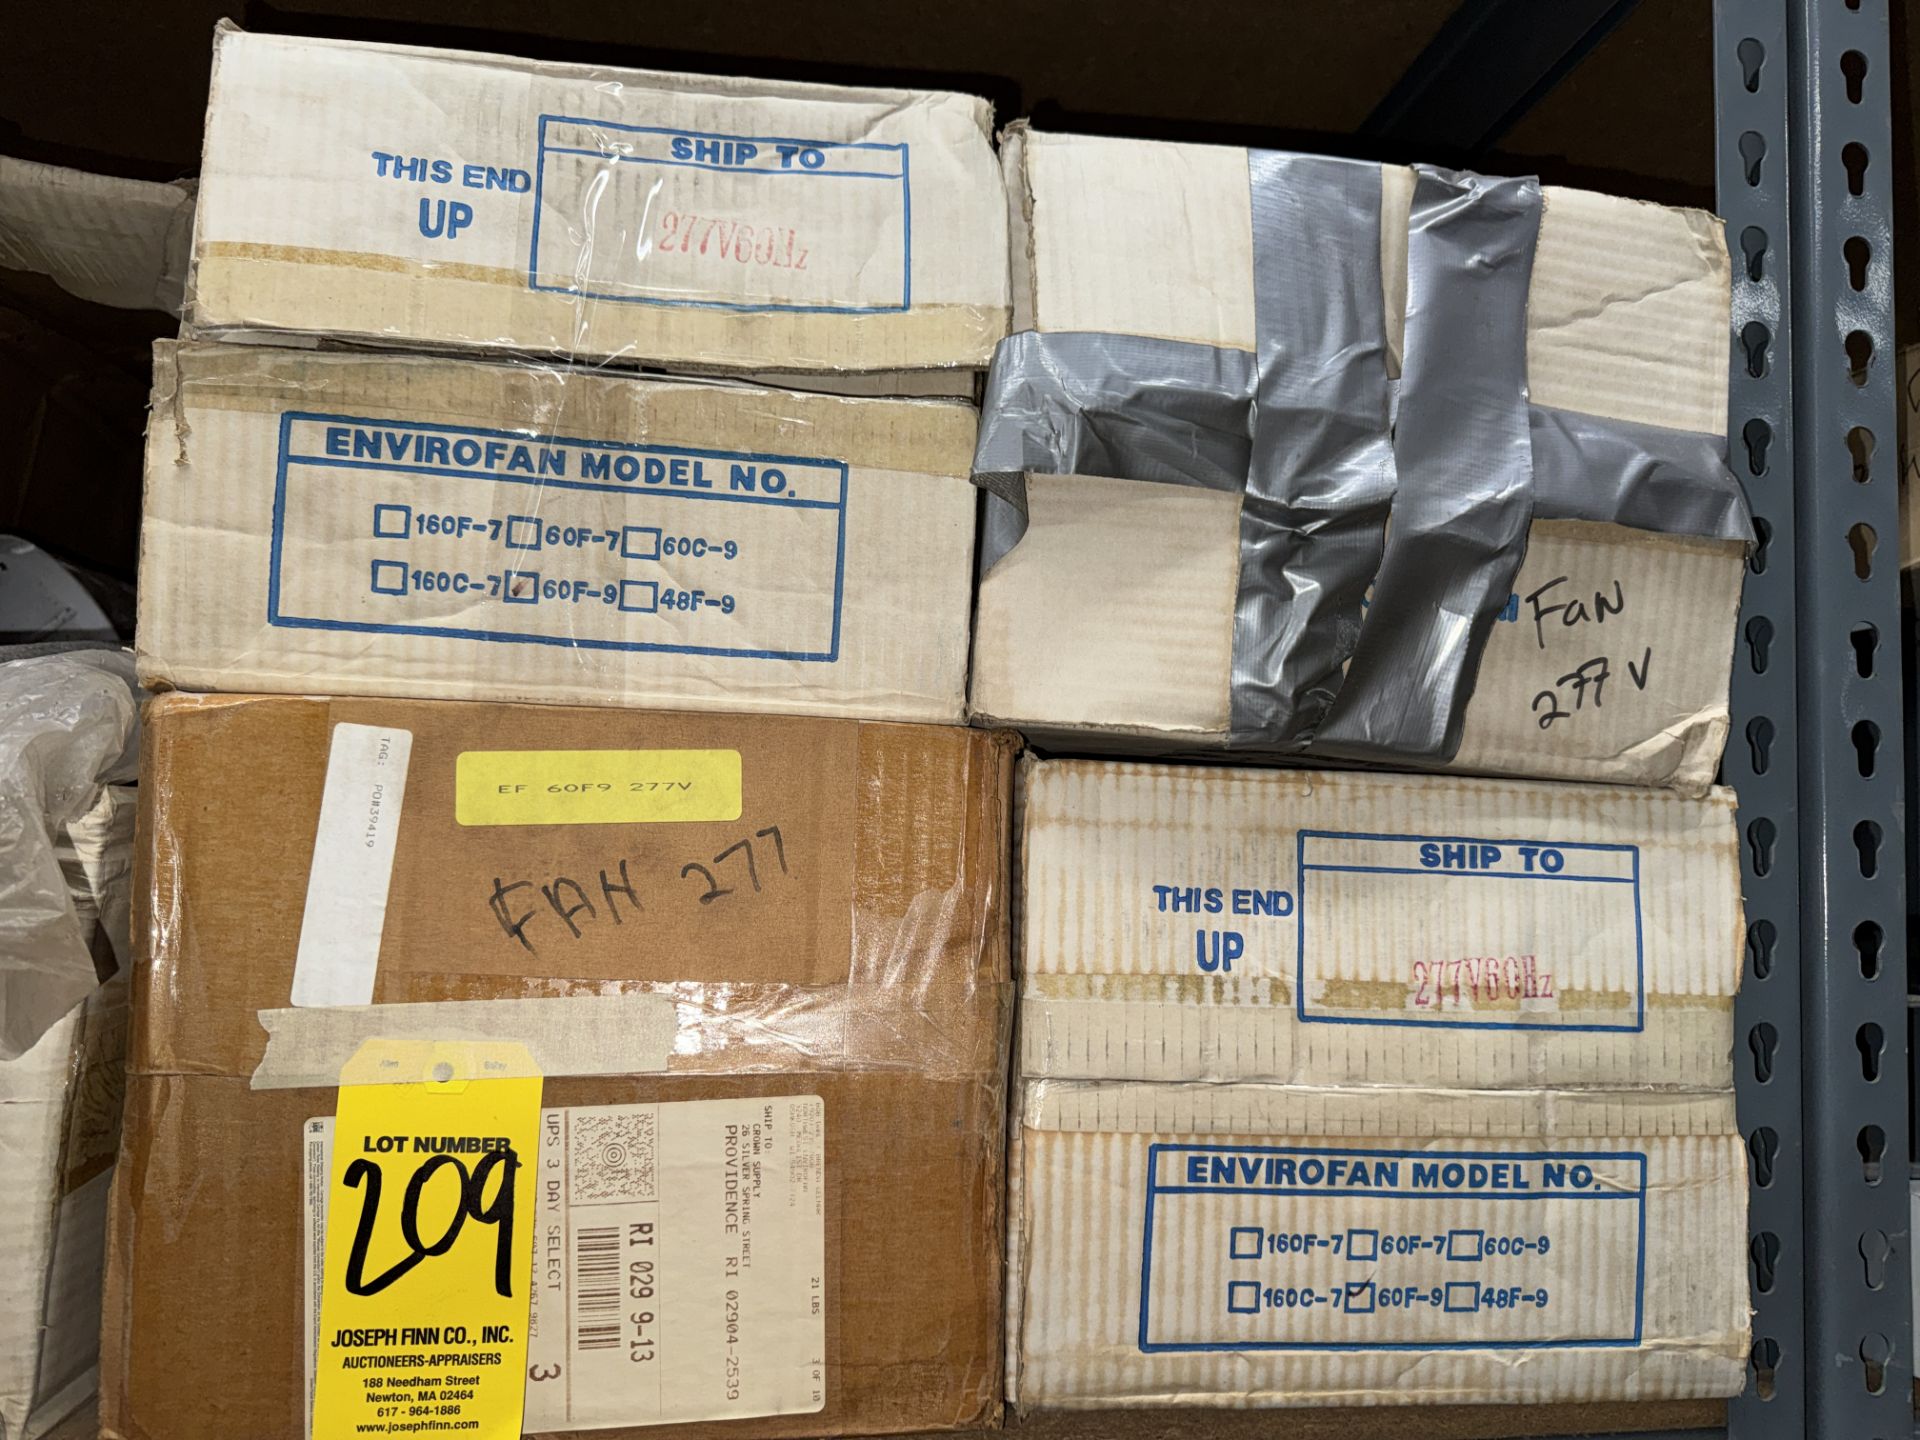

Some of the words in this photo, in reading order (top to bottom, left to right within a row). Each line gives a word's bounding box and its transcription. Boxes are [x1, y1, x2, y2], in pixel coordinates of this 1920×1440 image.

[671, 137, 758, 165] SHIP
[776, 145, 825, 169] TO
[372, 151, 453, 183] THIS
[463, 164, 531, 193] END
[419, 198, 473, 239] UP
[659, 211, 809, 270] 277V60Hz
[326, 427, 566, 476] ENVIROFAN
[581, 453, 712, 489] MODEL
[730, 465, 796, 498] NO.
[416, 513, 502, 541] 160F-7
[545, 524, 622, 552] 60F-7
[662, 536, 738, 560] 60C-9
[411, 568, 501, 595] 160C-7
[543, 580, 617, 605] 60F-9
[660, 589, 736, 615] 48F-9
[1532, 656, 1610, 729] 277
[1628, 646, 1651, 691] V
[377, 737, 390, 766] TAG:
[498, 784, 528, 795] EF
[547, 782, 613, 794] 60F9
[629, 781, 693, 792] 277V
[365, 784, 384, 848] PO#39419
[681, 825, 788, 905] 277
[1419, 843, 1501, 869] SHIP
[1519, 847, 1564, 873] TO
[1152, 884, 1223, 914] THIS
[1232, 889, 1294, 917] END
[1196, 929, 1245, 973] UP
[1413, 954, 1554, 1006] 277V60Hz
[363, 1136, 408, 1152] LOT
[413, 1136, 512, 1153] NUMBER
[546, 1113, 560, 1147] UPS
[742, 1124, 751, 1137] 26
[752, 1123, 761, 1155] CROWN
[547, 1159, 560, 1169] 3
[742, 1143, 751, 1180] SILVER
[1187, 1156, 1399, 1188] ENVIROFAN
[1412, 1163, 1530, 1189] MODEL
[1542, 1164, 1601, 1191] NO.
[725, 1124, 738, 1235] PROVIDENCE
[752, 1161, 761, 1198] SUPPLY
[547, 1180, 560, 1213] DAY
[742, 1187, 751, 1225] SPRING
[343, 1148, 523, 1298] 209
[629, 1223, 654, 1246] RI
[547, 1225, 562, 1292] SELECT
[742, 1230, 751, 1268] STREET
[1266, 1233, 1344, 1254] 160F-7
[1380, 1235, 1447, 1255] 60F-7
[1484, 1236, 1551, 1256] 60C-9
[629, 1261, 655, 1299] 029
[726, 1257, 739, 1278] RI
[811, 1277, 820, 1289] 21
[811, 1295, 820, 1315] LBS
[1263, 1287, 1343, 1309] 160C-7
[1378, 1288, 1443, 1308] 60F-9
[1481, 1288, 1548, 1309] 48F-9
[331, 1328, 397, 1347] JOSEPH
[401, 1327, 440, 1346] FINN
[443, 1326, 477, 1346] CO.,
[482, 1325, 514, 1344] INC.
[629, 1312, 656, 1363] 9-13
[726, 1290, 740, 1401] 02904-2539
[342, 1352, 502, 1369] AUCTIONEERS-APPRAISERS
[529, 1362, 562, 1382] 3
[812, 1369, 821, 1382] OF
[362, 1378, 383, 1388] 188
[387, 1376, 441, 1387] Needham
[445, 1375, 480, 1386] Street
[366, 1392, 414, 1404] Newton,
[418, 1391, 437, 1401] MA
[440, 1390, 474, 1401] 02464
[812, 1389, 821, 1402] 10
[356, 1420, 479, 1434] www.josephfinn.com
[377, 1407, 398, 1417] 617
[409, 1405, 461, 1416] 964-1886
